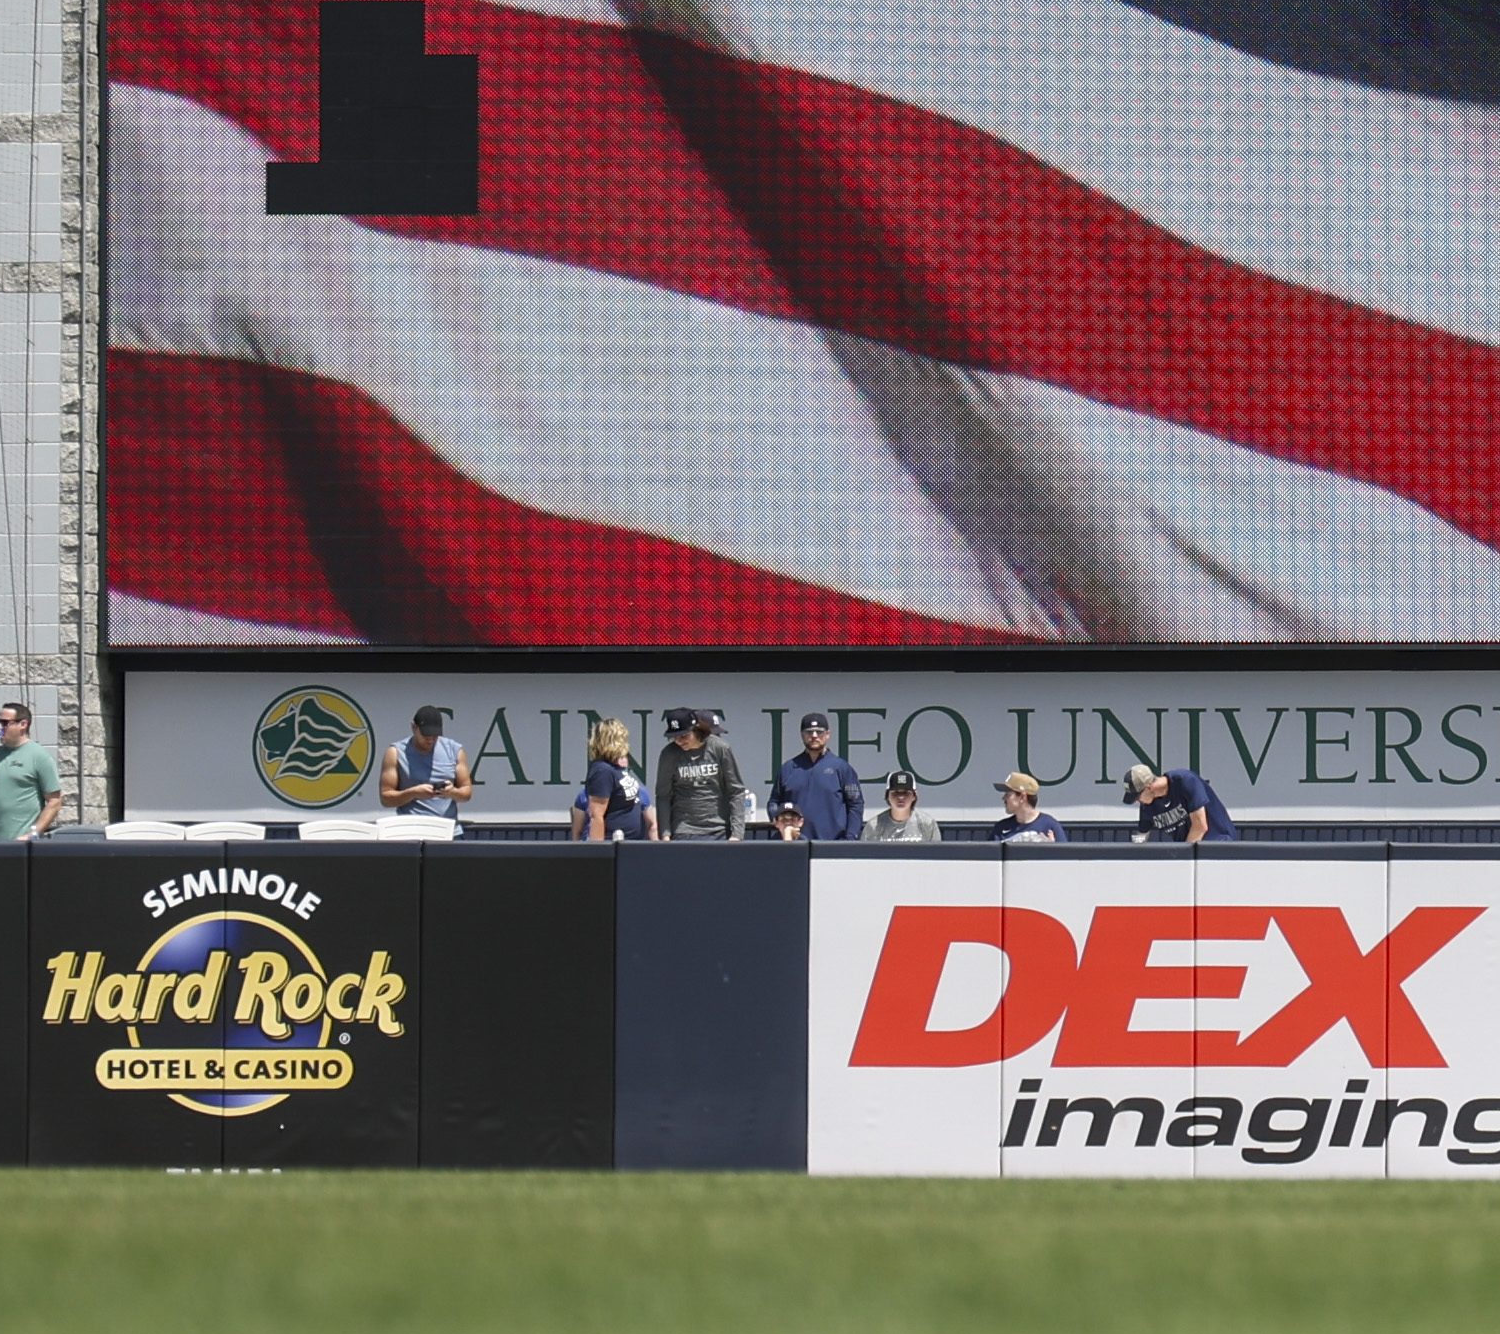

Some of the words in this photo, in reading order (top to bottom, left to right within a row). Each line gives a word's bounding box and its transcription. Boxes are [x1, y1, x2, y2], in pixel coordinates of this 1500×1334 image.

[437, 707, 725, 785] AIN
[678, 763, 719, 778] YANKEES
[143, 868, 321, 920] SEMINOLE
[43, 951, 231, 1024] Hard
[234, 951, 406, 1038] Rock
[848, 905, 1488, 1068] DEX
[107, 1059, 197, 1080] HOTEL
[204, 1059, 225, 1080] &
[233, 1059, 343, 1080] CASINO
